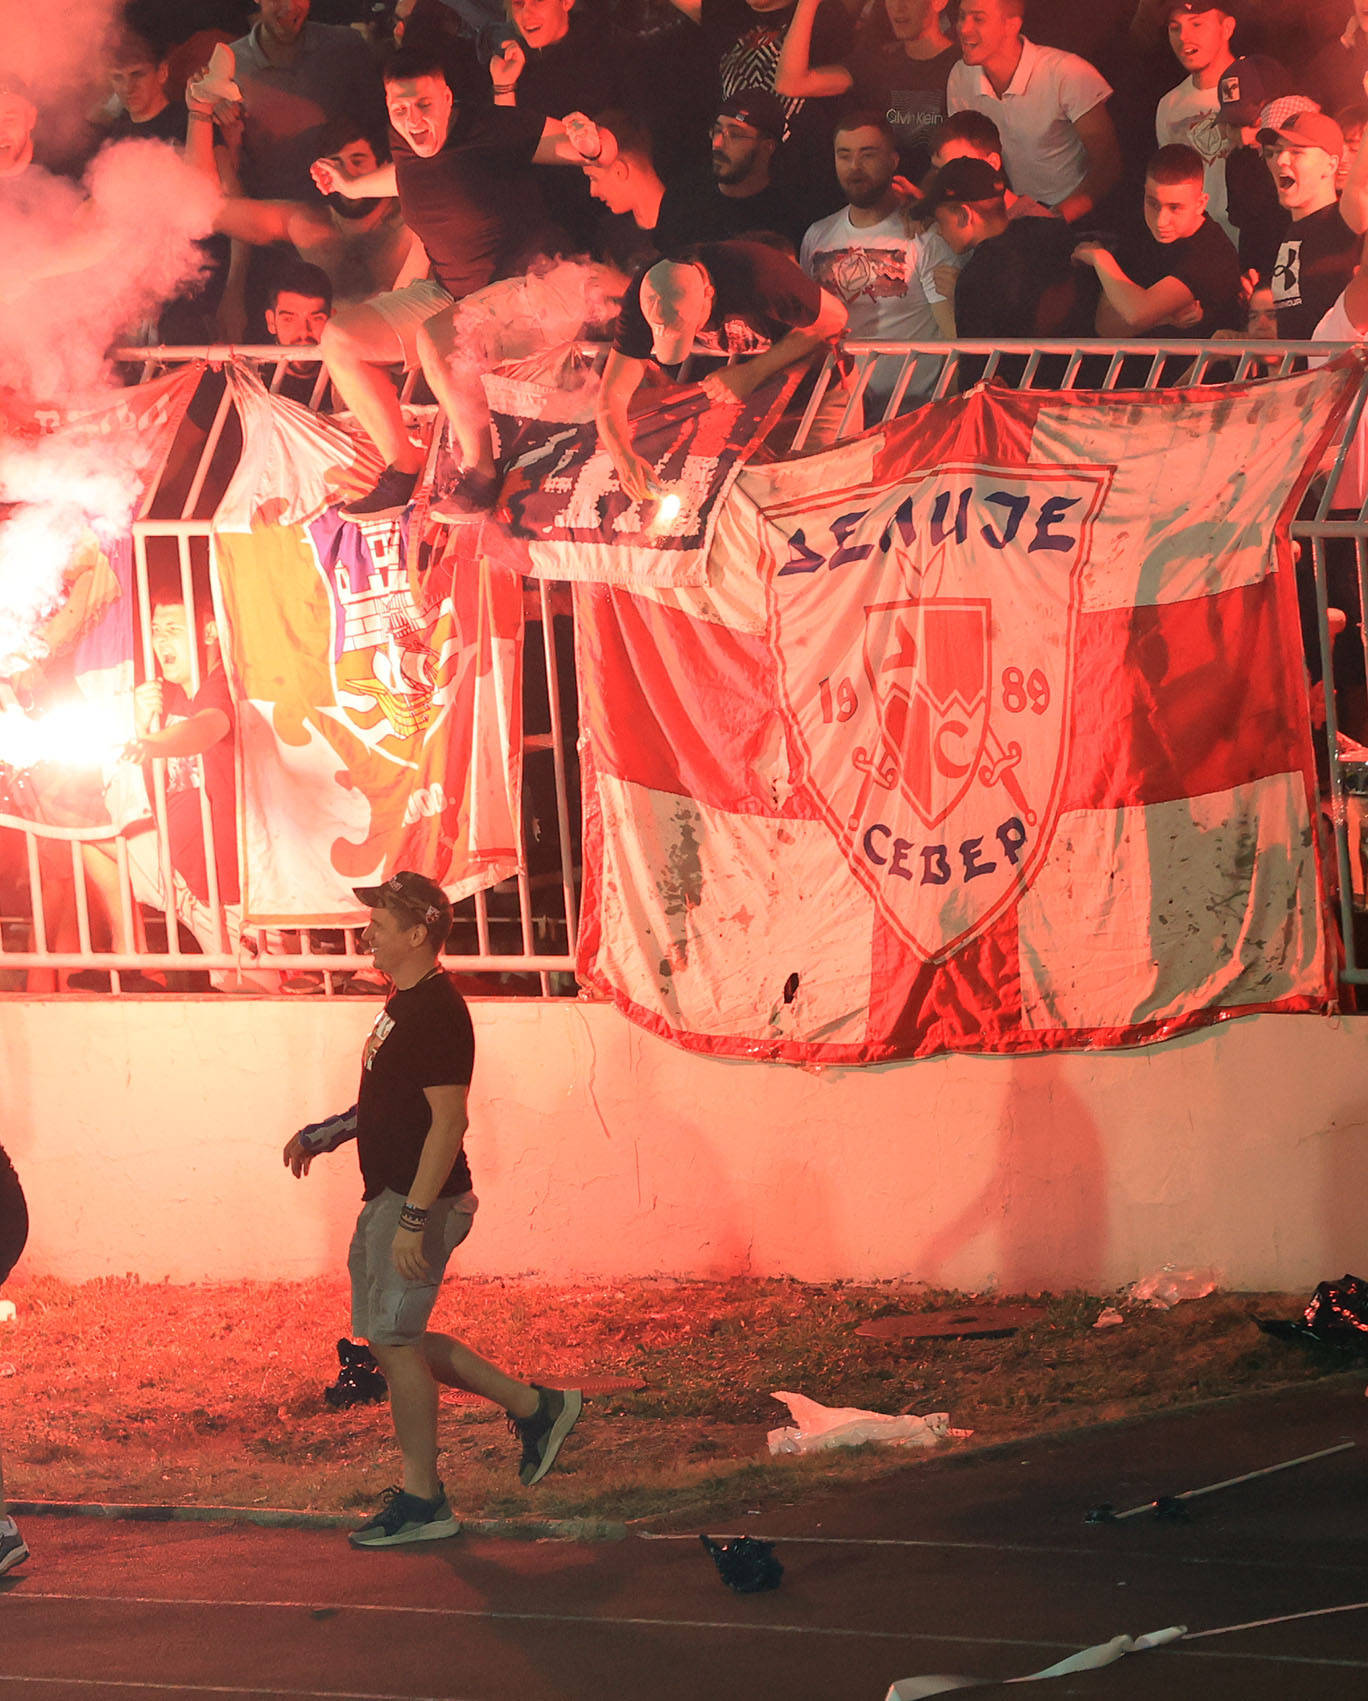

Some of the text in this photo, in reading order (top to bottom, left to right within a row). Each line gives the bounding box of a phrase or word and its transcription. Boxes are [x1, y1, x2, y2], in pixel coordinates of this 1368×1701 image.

[819, 666, 1051, 724] 19 89
[863, 816, 1027, 886] СЕВЕР
